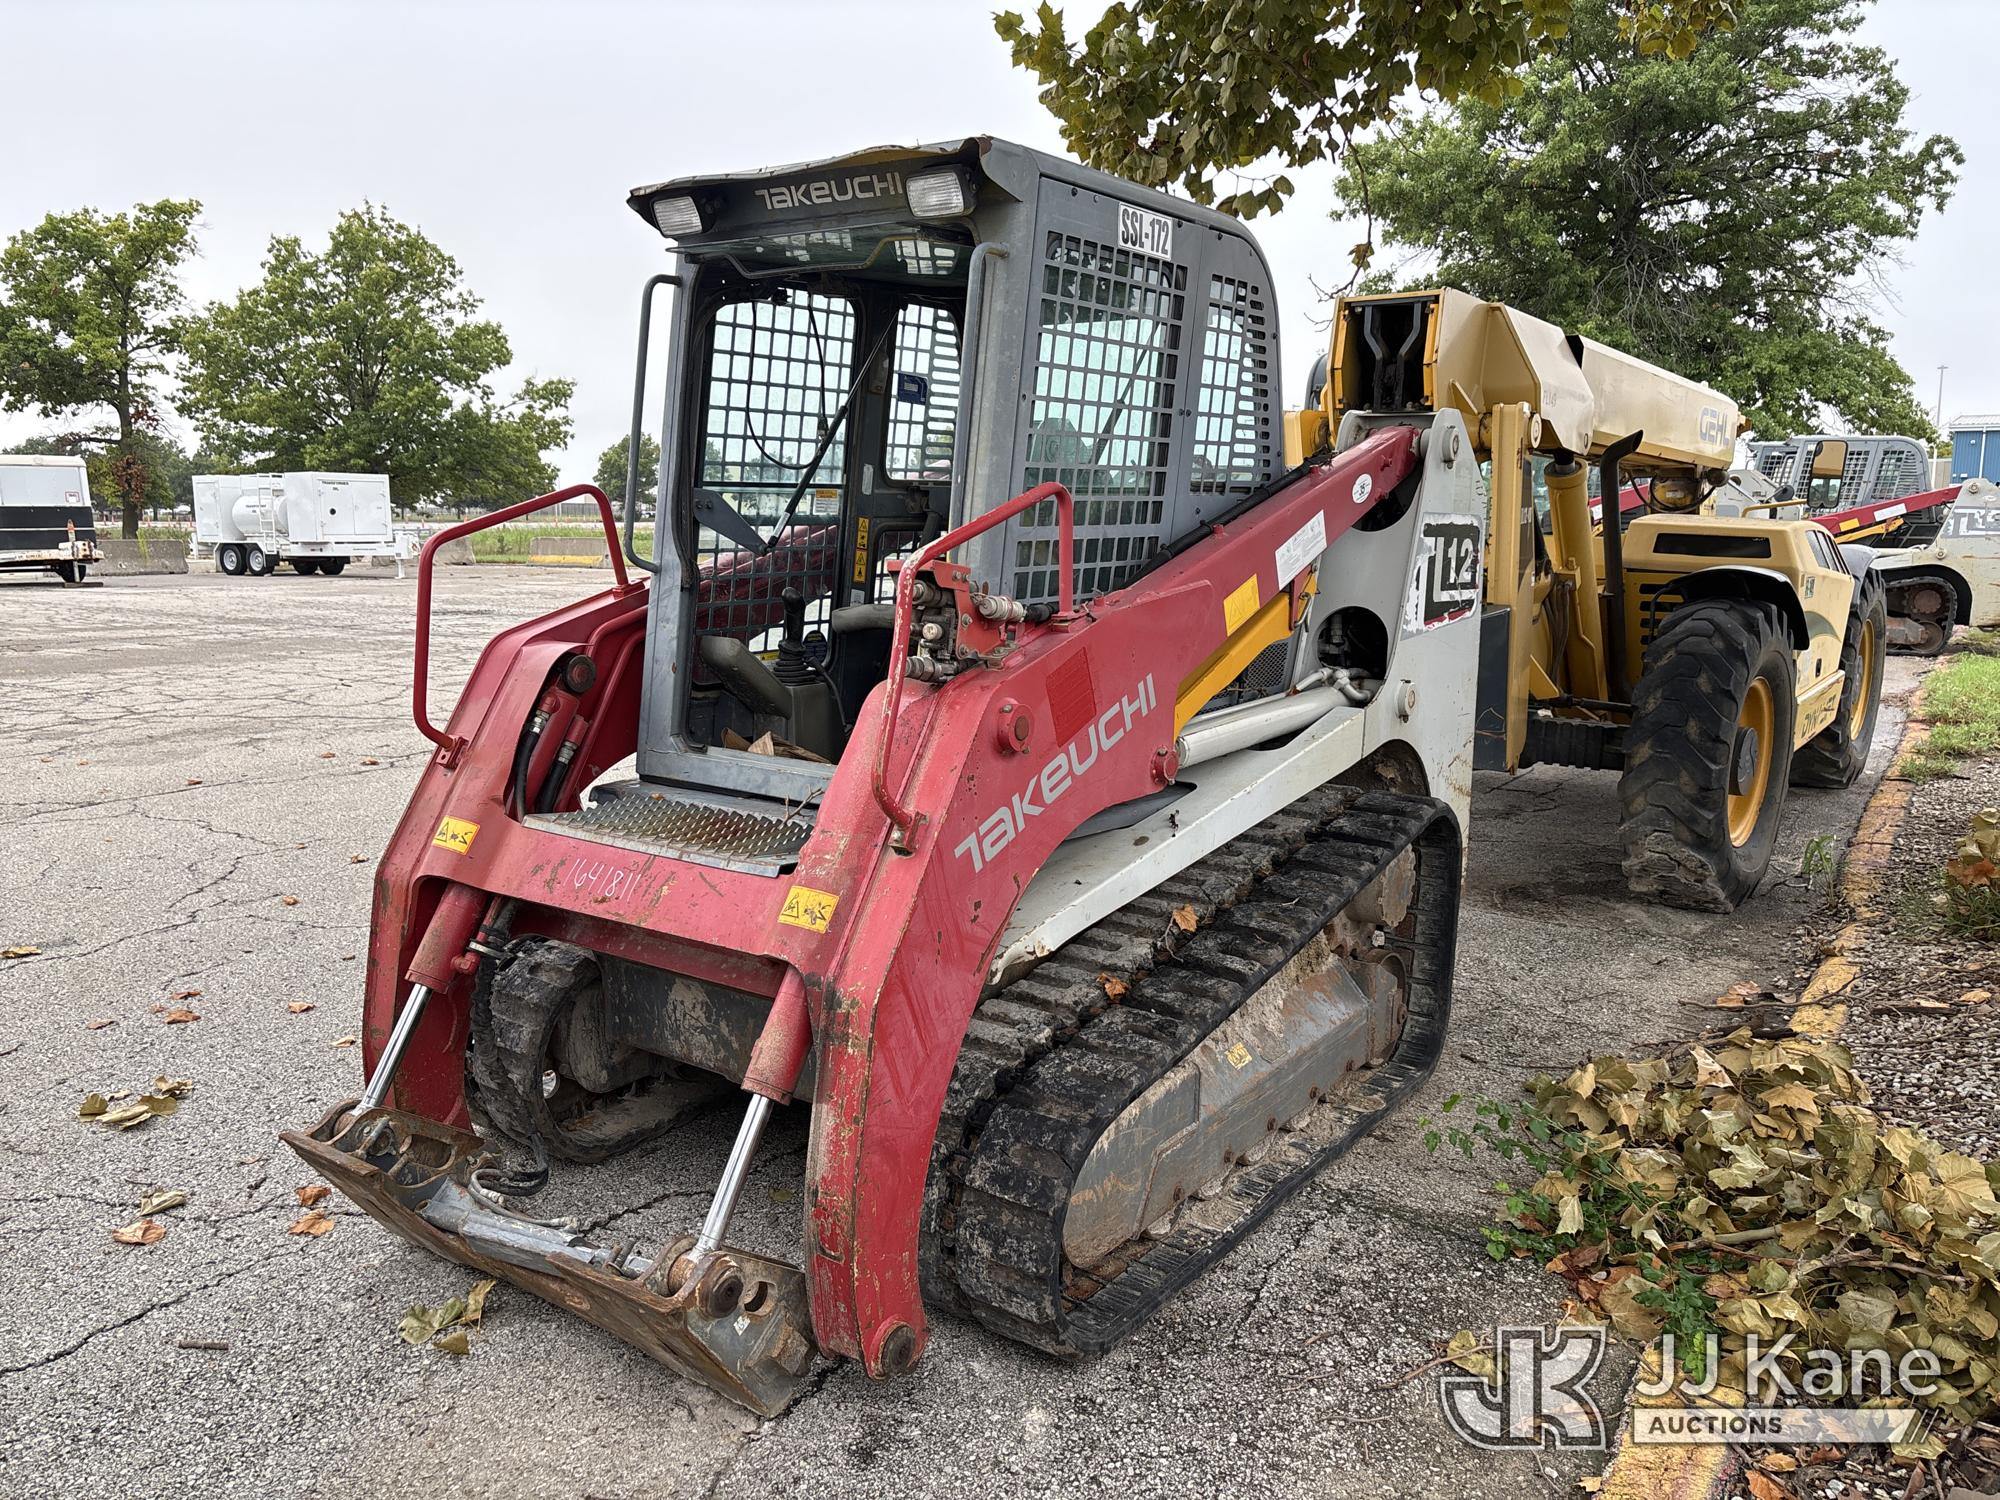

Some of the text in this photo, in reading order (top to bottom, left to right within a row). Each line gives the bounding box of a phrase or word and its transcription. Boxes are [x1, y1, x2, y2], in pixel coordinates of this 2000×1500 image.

[755, 171, 903, 210] TAKEUCHI
[1121, 208, 1169, 256] SSL-172
[954, 673, 1157, 873] TAKEUCHI
[563, 859, 641, 901] 1641811
